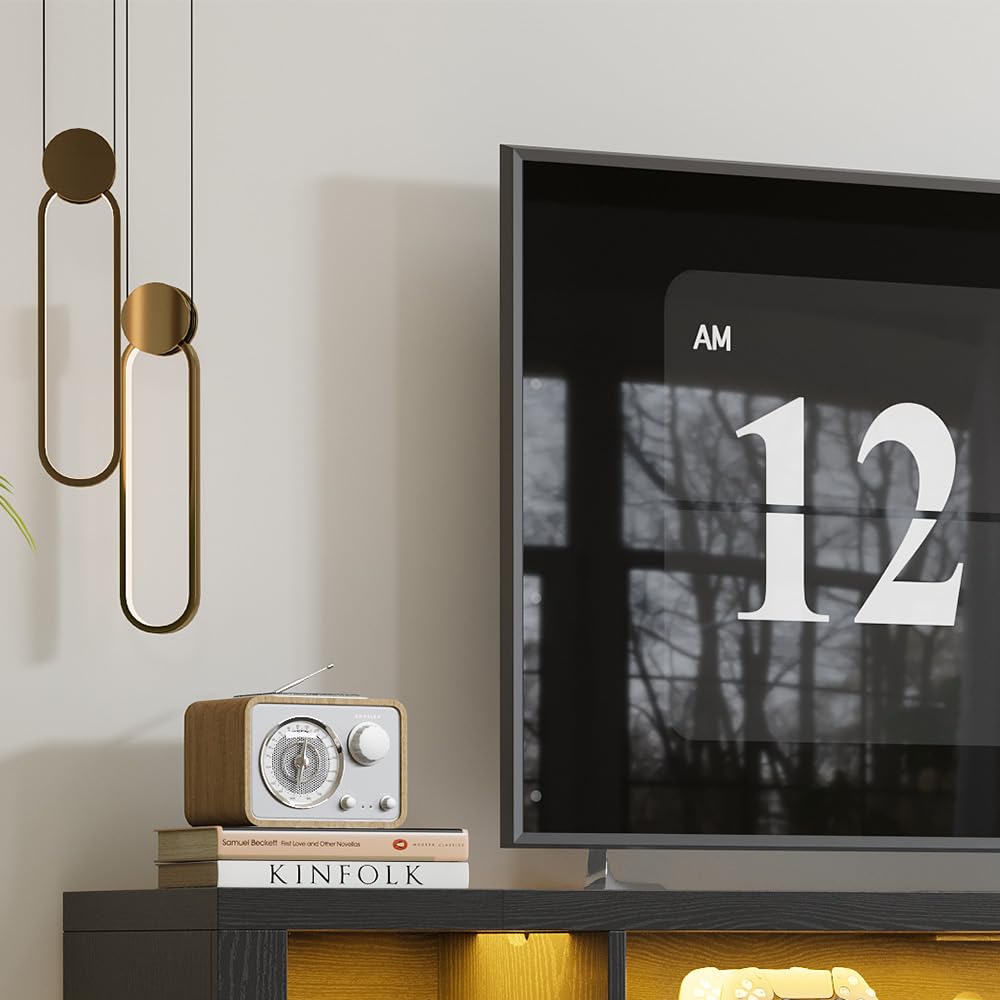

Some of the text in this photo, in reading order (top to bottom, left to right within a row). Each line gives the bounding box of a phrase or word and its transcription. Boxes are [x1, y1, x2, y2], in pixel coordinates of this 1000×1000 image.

[692, 323, 732, 352] AM
[735, 396, 965, 627] 12
[222, 838, 361, 848] Samuel Beckett First Love and Other Novellas
[268, 864, 425, 886] KINFOLK
